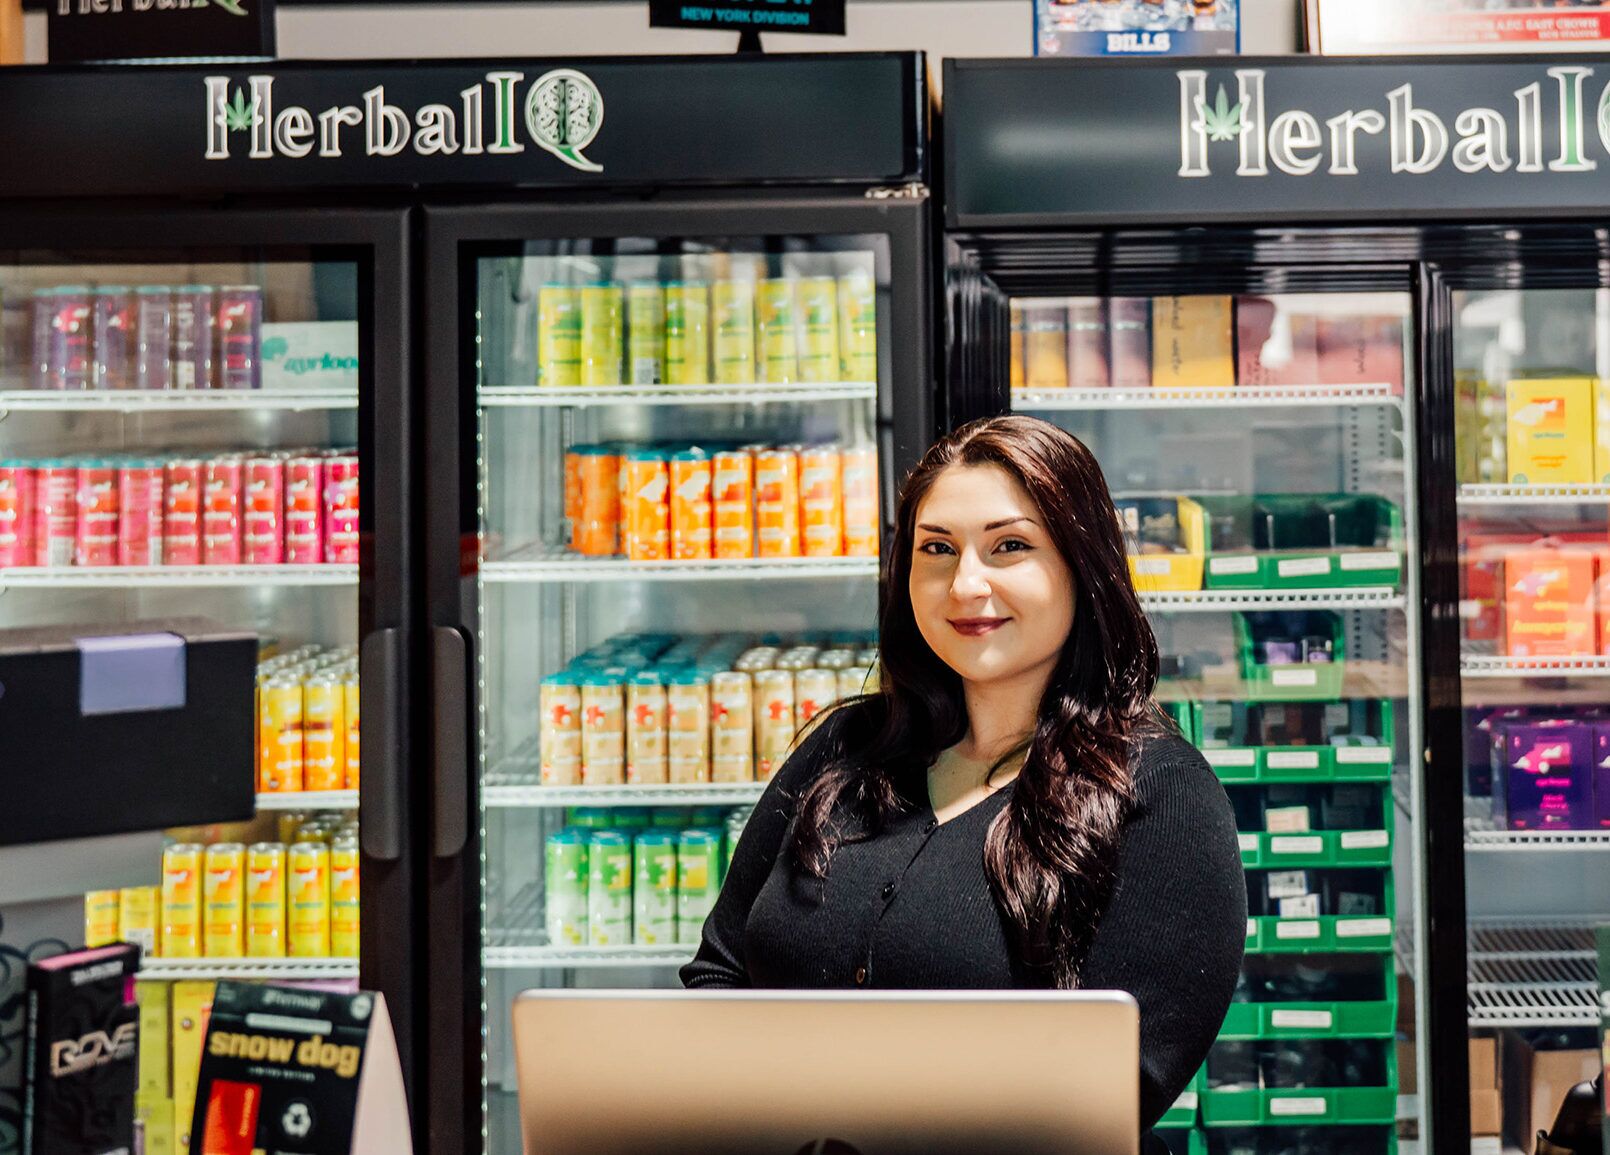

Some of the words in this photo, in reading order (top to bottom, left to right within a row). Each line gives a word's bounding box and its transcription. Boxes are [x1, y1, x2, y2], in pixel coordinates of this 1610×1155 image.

[680, 6, 713, 21] NEW
[715, 9, 750, 23] YORK
[752, 10, 811, 26] DIVISION
[1106, 33, 1171, 52] BILLS
[205, 68, 604, 172] HerbalIQ
[1177, 66, 1610, 178] HerbalI
[284, 352, 358, 375] ayrloo
[51, 1021, 137, 1078] ROVE
[208, 1031, 295, 1063] snow
[296, 1034, 362, 1078] dog
